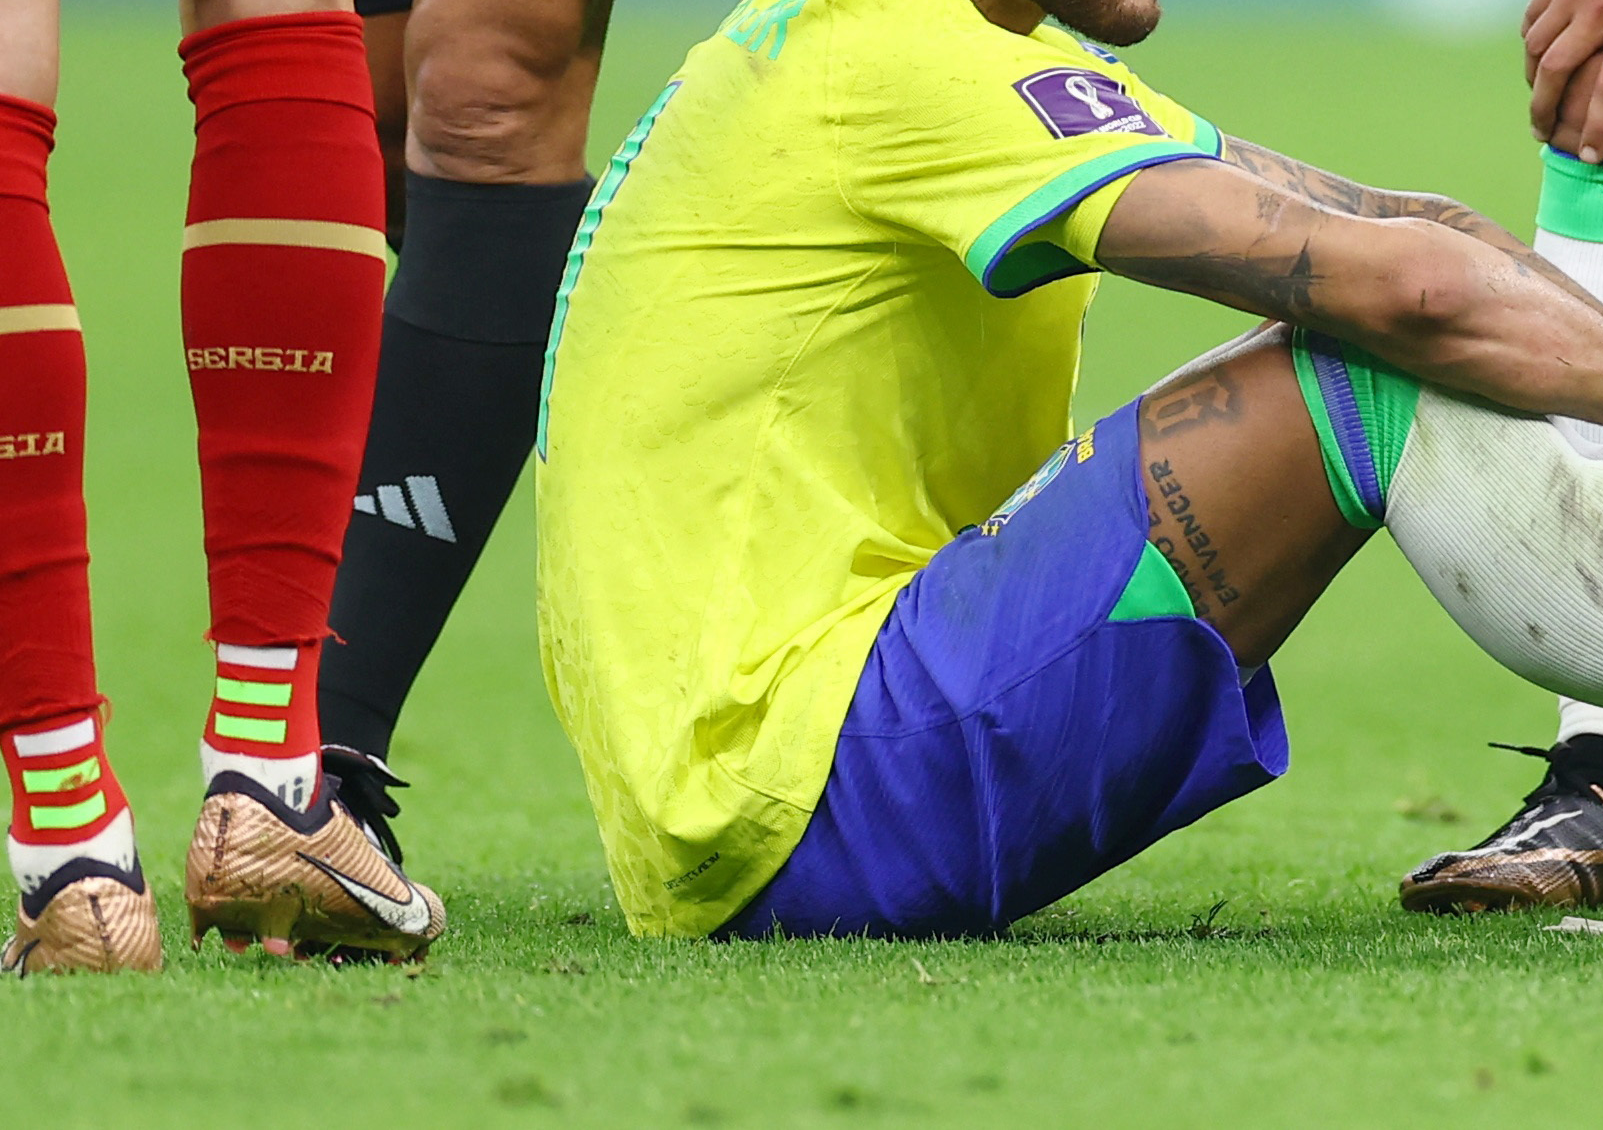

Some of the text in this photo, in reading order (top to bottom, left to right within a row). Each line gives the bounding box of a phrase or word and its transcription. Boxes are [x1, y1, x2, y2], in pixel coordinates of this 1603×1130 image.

[0, 431, 65, 460] BIA
[1149, 456, 1218, 571] VENCER
[1206, 570, 1240, 608] EM
